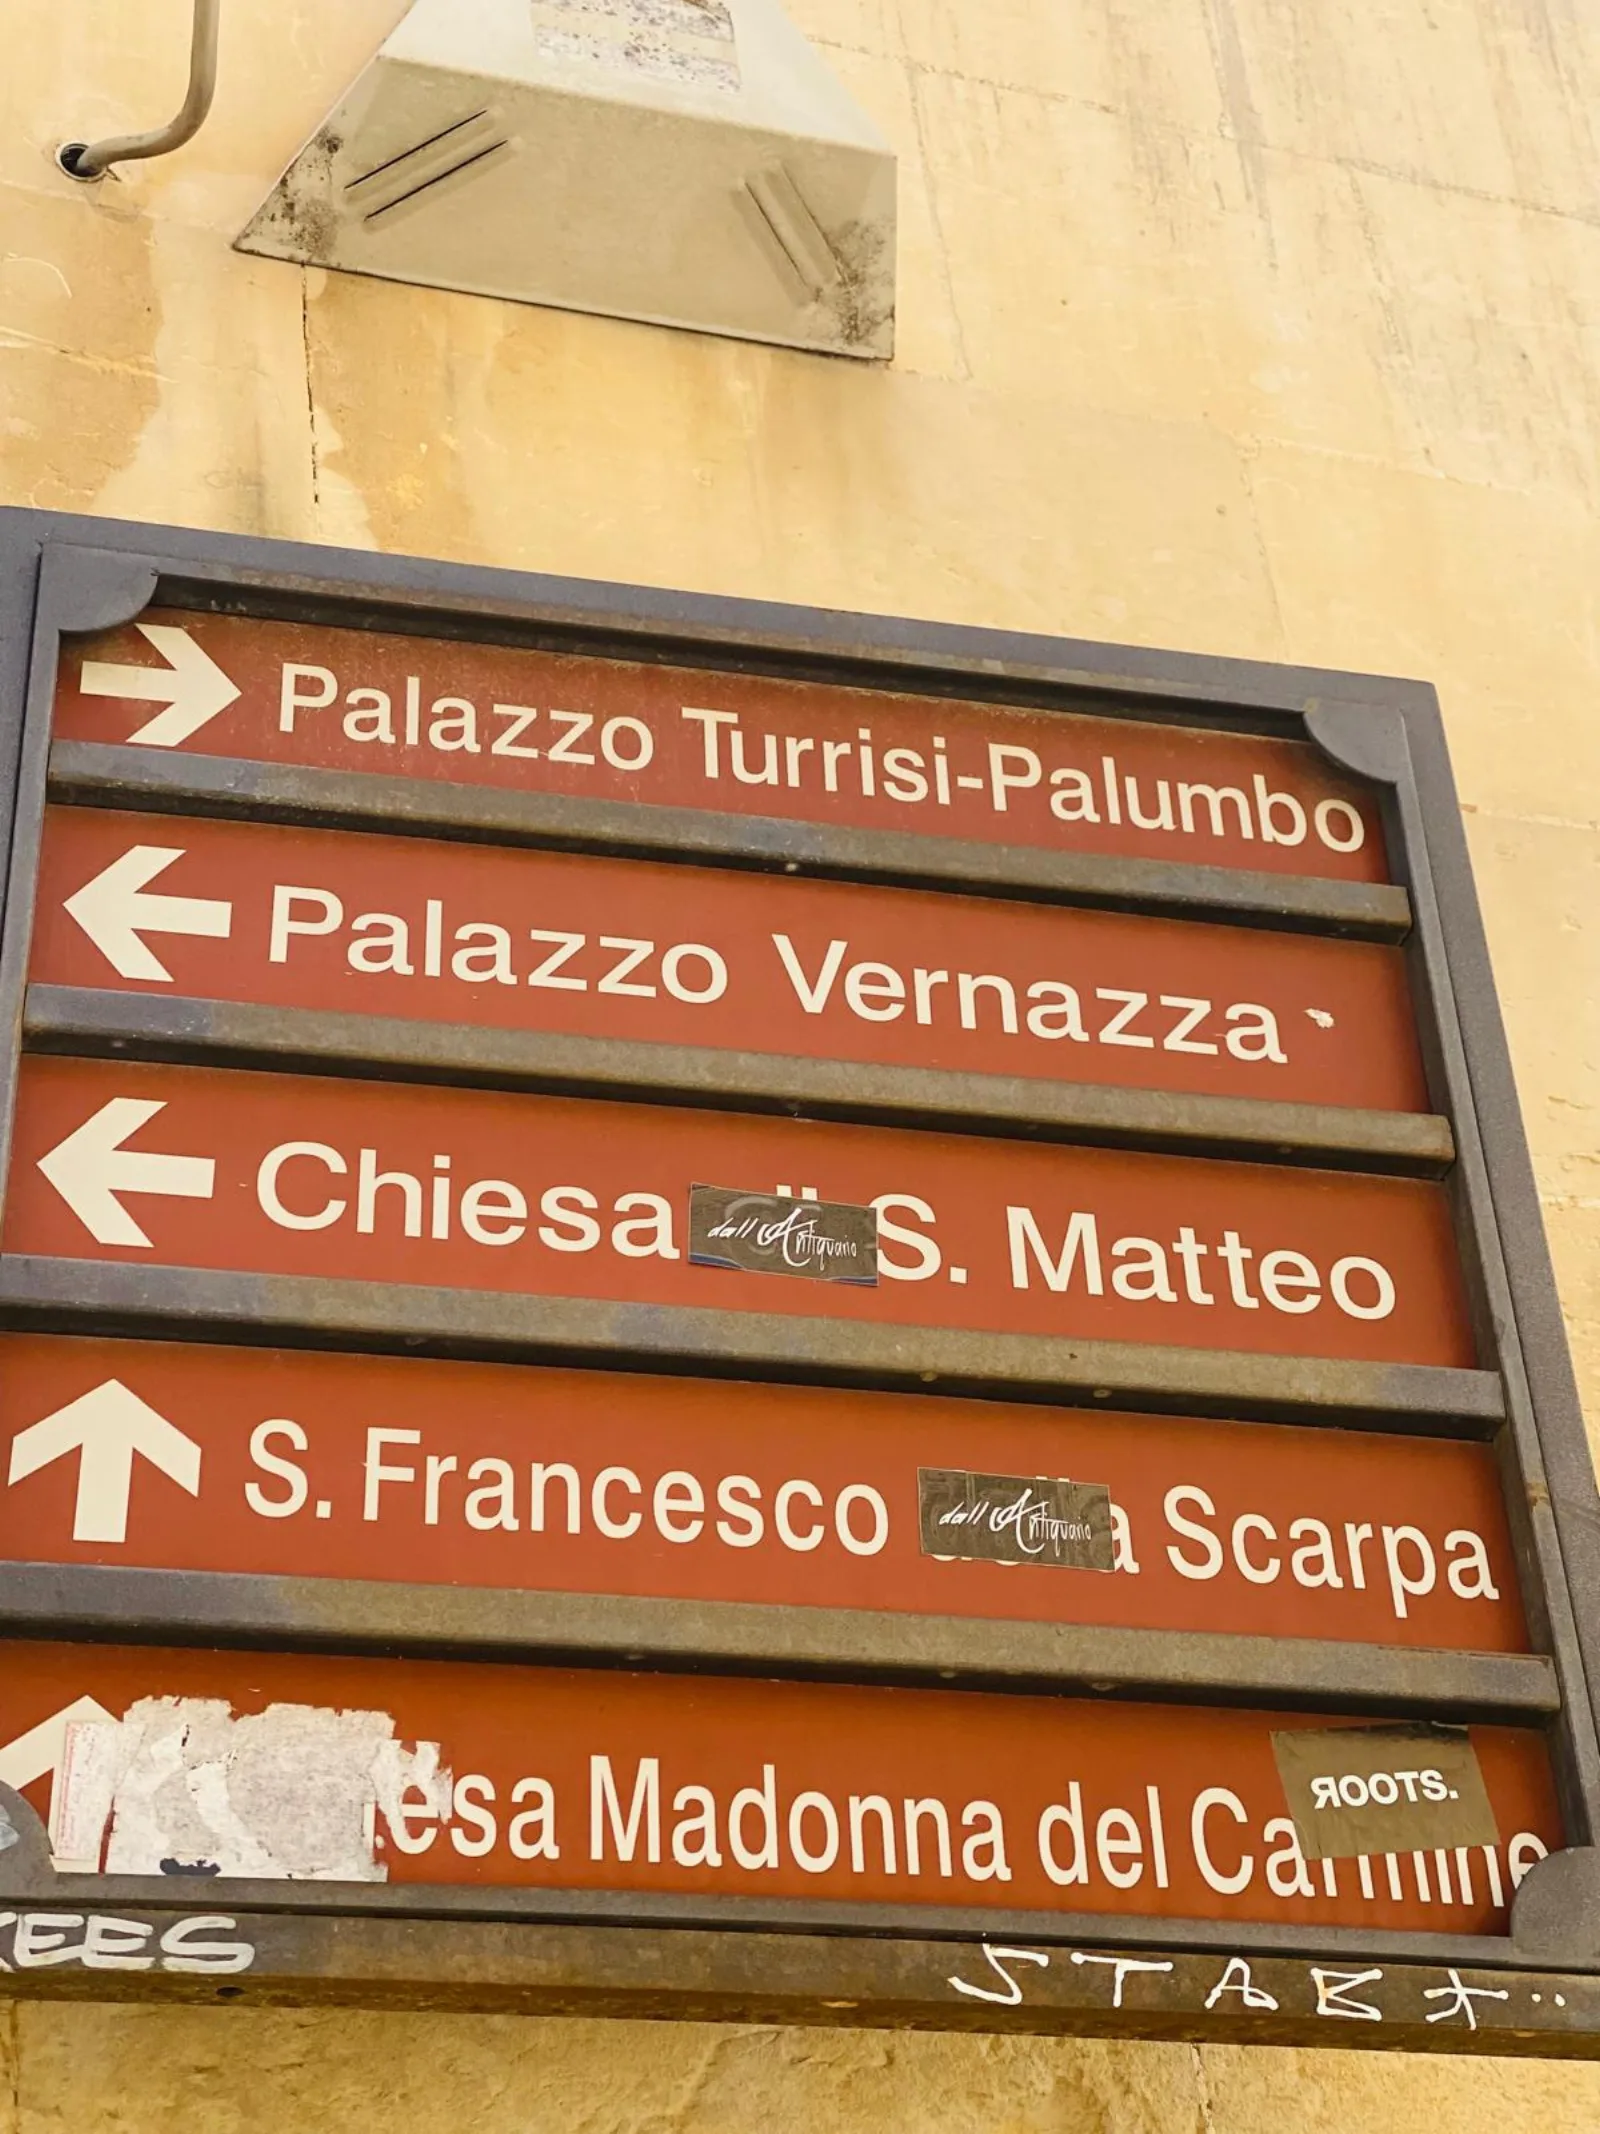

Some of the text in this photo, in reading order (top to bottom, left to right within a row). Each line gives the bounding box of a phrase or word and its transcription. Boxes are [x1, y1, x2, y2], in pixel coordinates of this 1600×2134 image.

[279, 663, 1364, 852] Palazzo Turrisi-Palumbo
[269, 885, 1287, 1064] Palazzo Vernazza
[257, 1141, 680, 1260] Chiesa
[867, 1194, 967, 1284] S.
[1007, 1206, 1396, 1320] Matteo
[245, 1419, 331, 1521] S.
[364, 1427, 889, 1556] Francesco
[1163, 1485, 1499, 1618] Scarpa
[591, 1755, 1012, 1884] Madonna
[1038, 1781, 1168, 1889] del
[0, 1910, 256, 1975] EES
